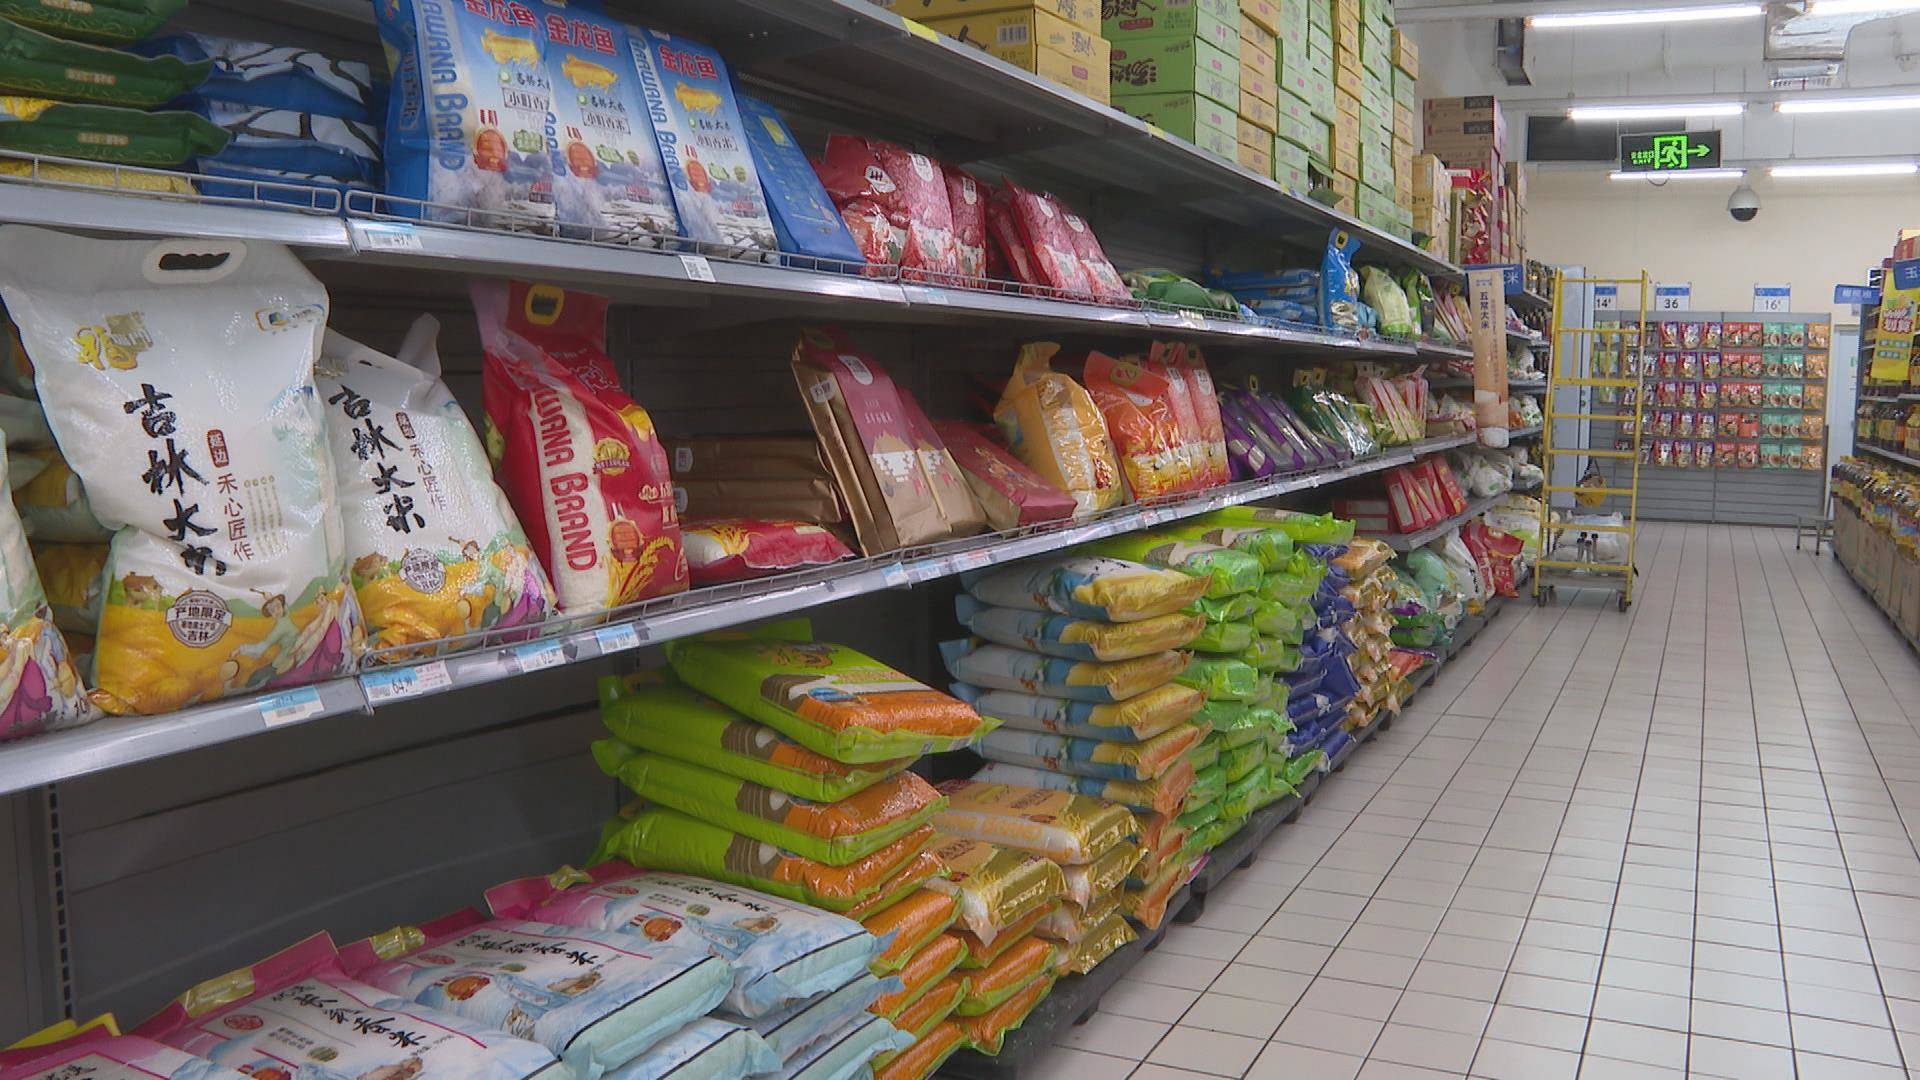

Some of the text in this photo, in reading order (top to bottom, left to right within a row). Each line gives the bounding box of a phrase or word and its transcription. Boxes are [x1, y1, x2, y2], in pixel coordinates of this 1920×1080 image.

[546, 13, 617, 56] 金龙鱼
[658, 45, 718, 80] 金龙鱼
[434, 93, 470, 172] BRAND
[1480, 291, 1489, 329] 五常大米
[1664, 299, 1679, 309] 36
[329, 384, 426, 534] 吉林大米
[217, 473, 254, 561] 禾心匠作
[550, 470, 598, 572] BRAND
[175, 606, 226, 620] 产地限定
